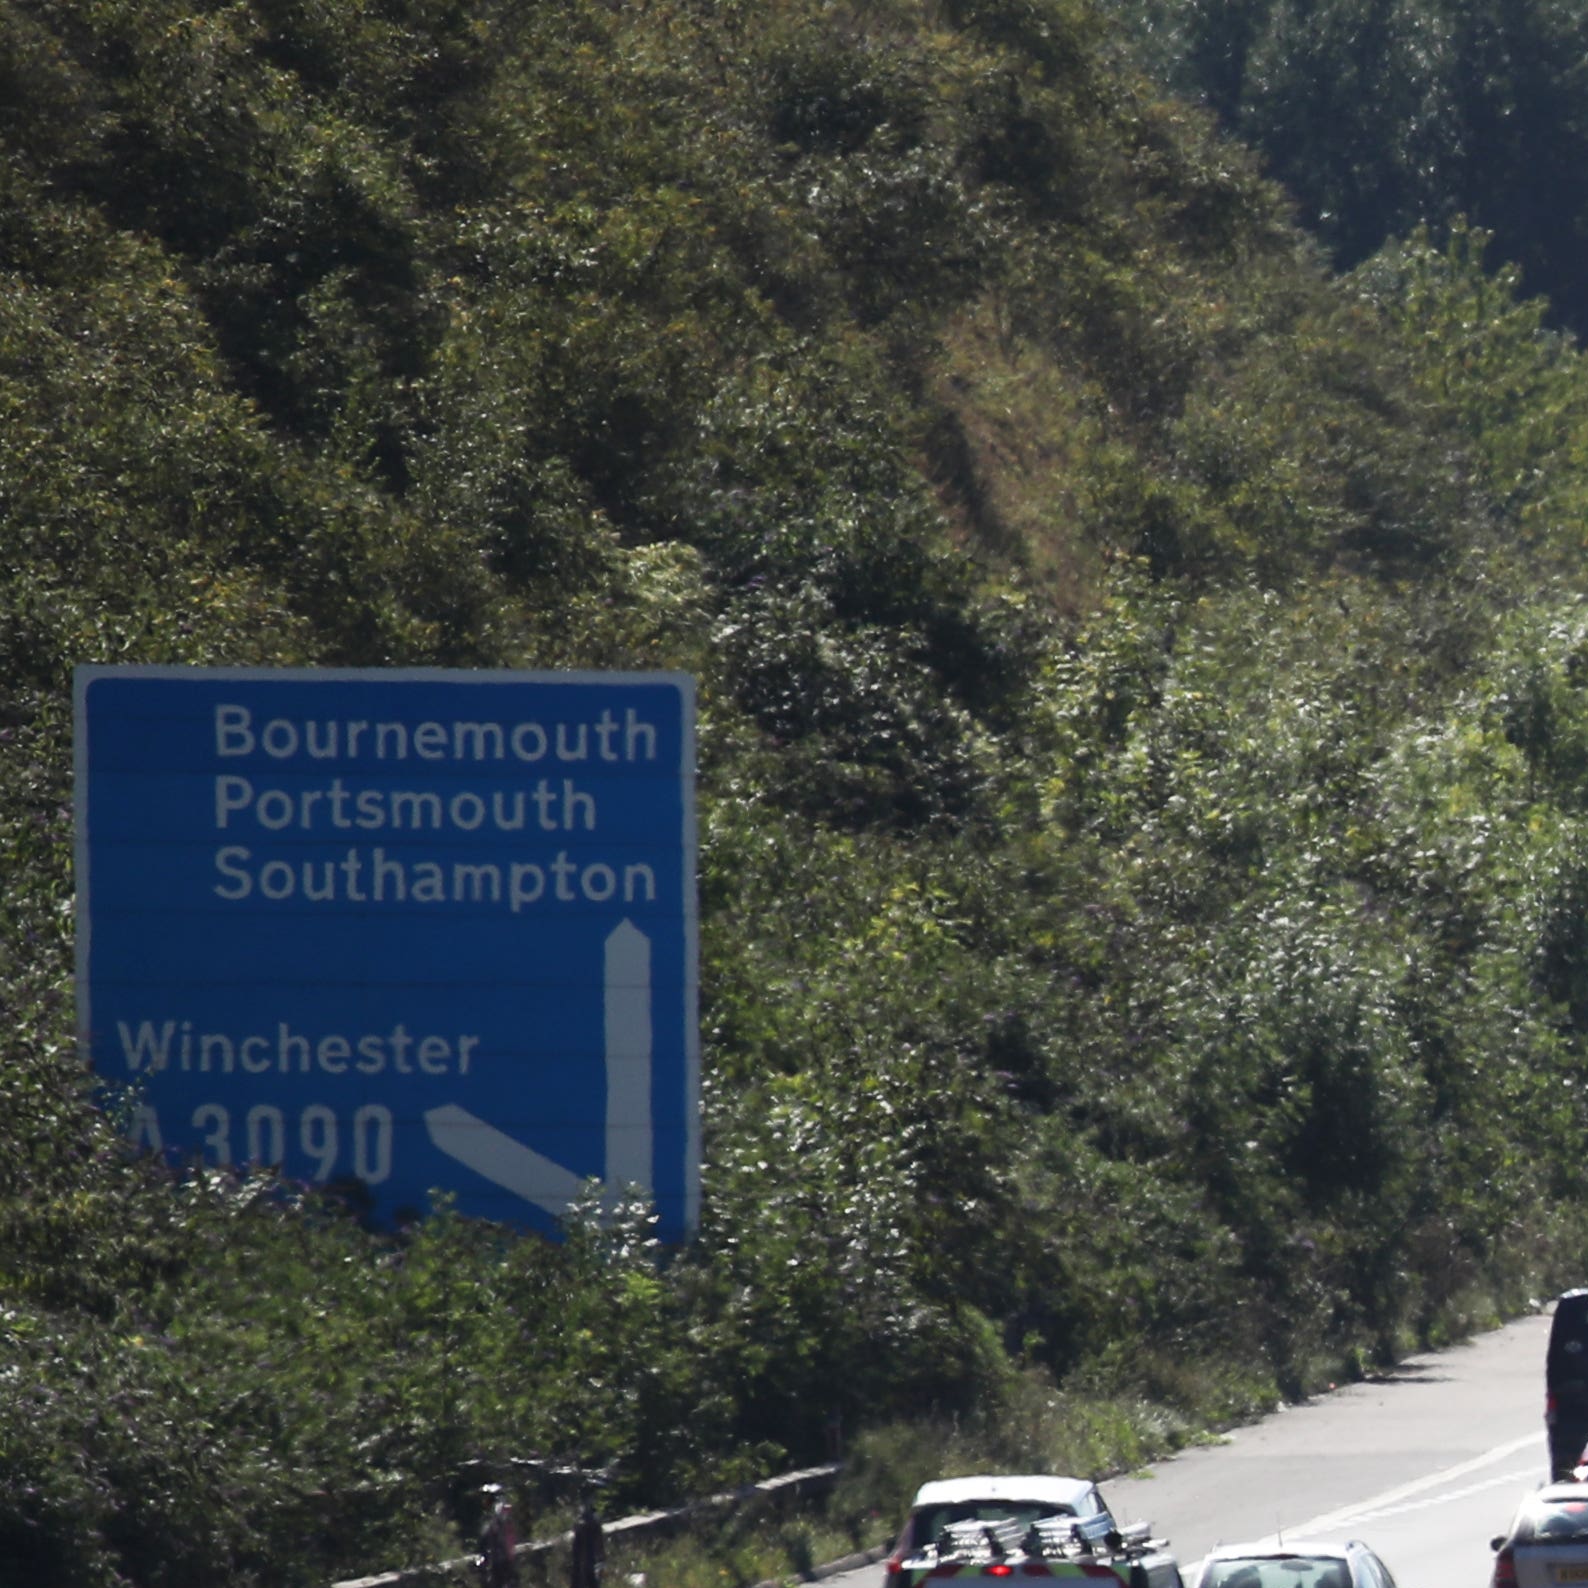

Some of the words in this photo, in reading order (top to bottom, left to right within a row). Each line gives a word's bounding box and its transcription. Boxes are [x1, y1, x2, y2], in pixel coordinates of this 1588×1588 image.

[214, 704, 657, 761] Bournemouth
[214, 775, 597, 830] Portsmouth
[213, 846, 656, 912] Southampton
[117, 1020, 479, 1075] Winchester
